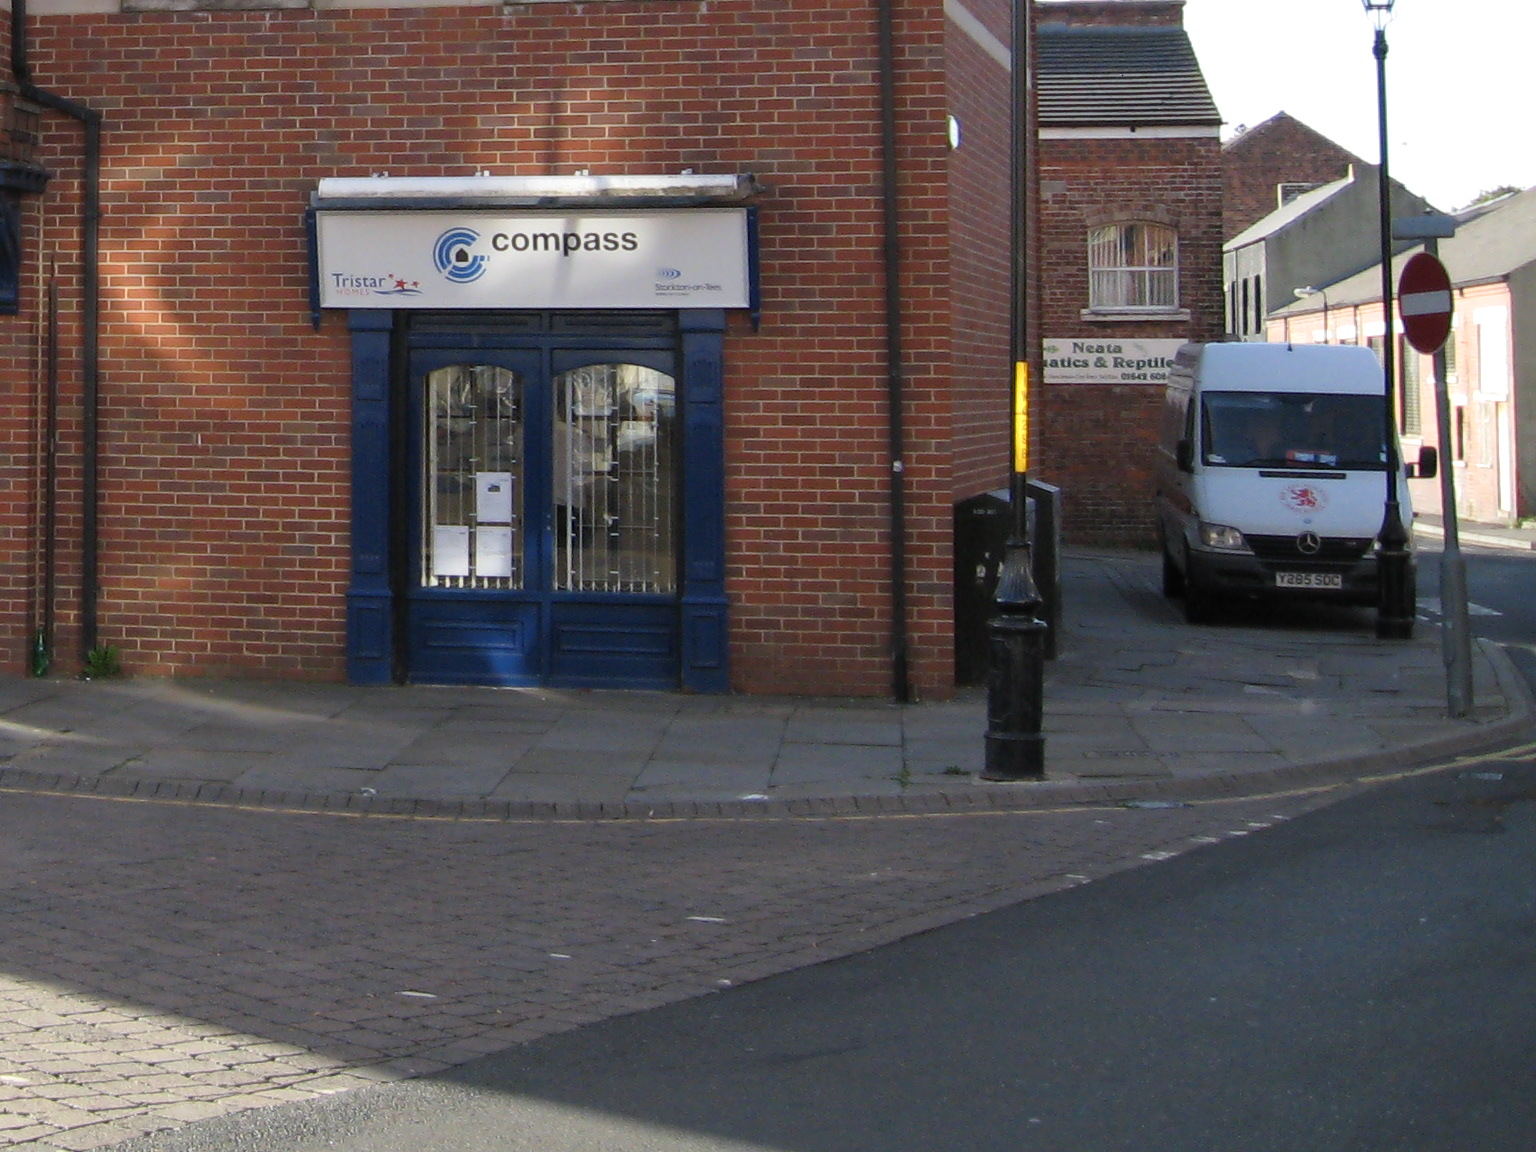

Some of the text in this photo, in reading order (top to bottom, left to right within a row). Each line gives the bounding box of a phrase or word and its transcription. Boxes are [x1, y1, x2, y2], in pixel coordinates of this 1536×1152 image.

[491, 232, 639, 257] compass
[331, 272, 386, 288] Tristar
[1072, 342, 1123, 354] Neata
[1094, 356, 1109, 369] &
[1112, 356, 1175, 371] Reptile
